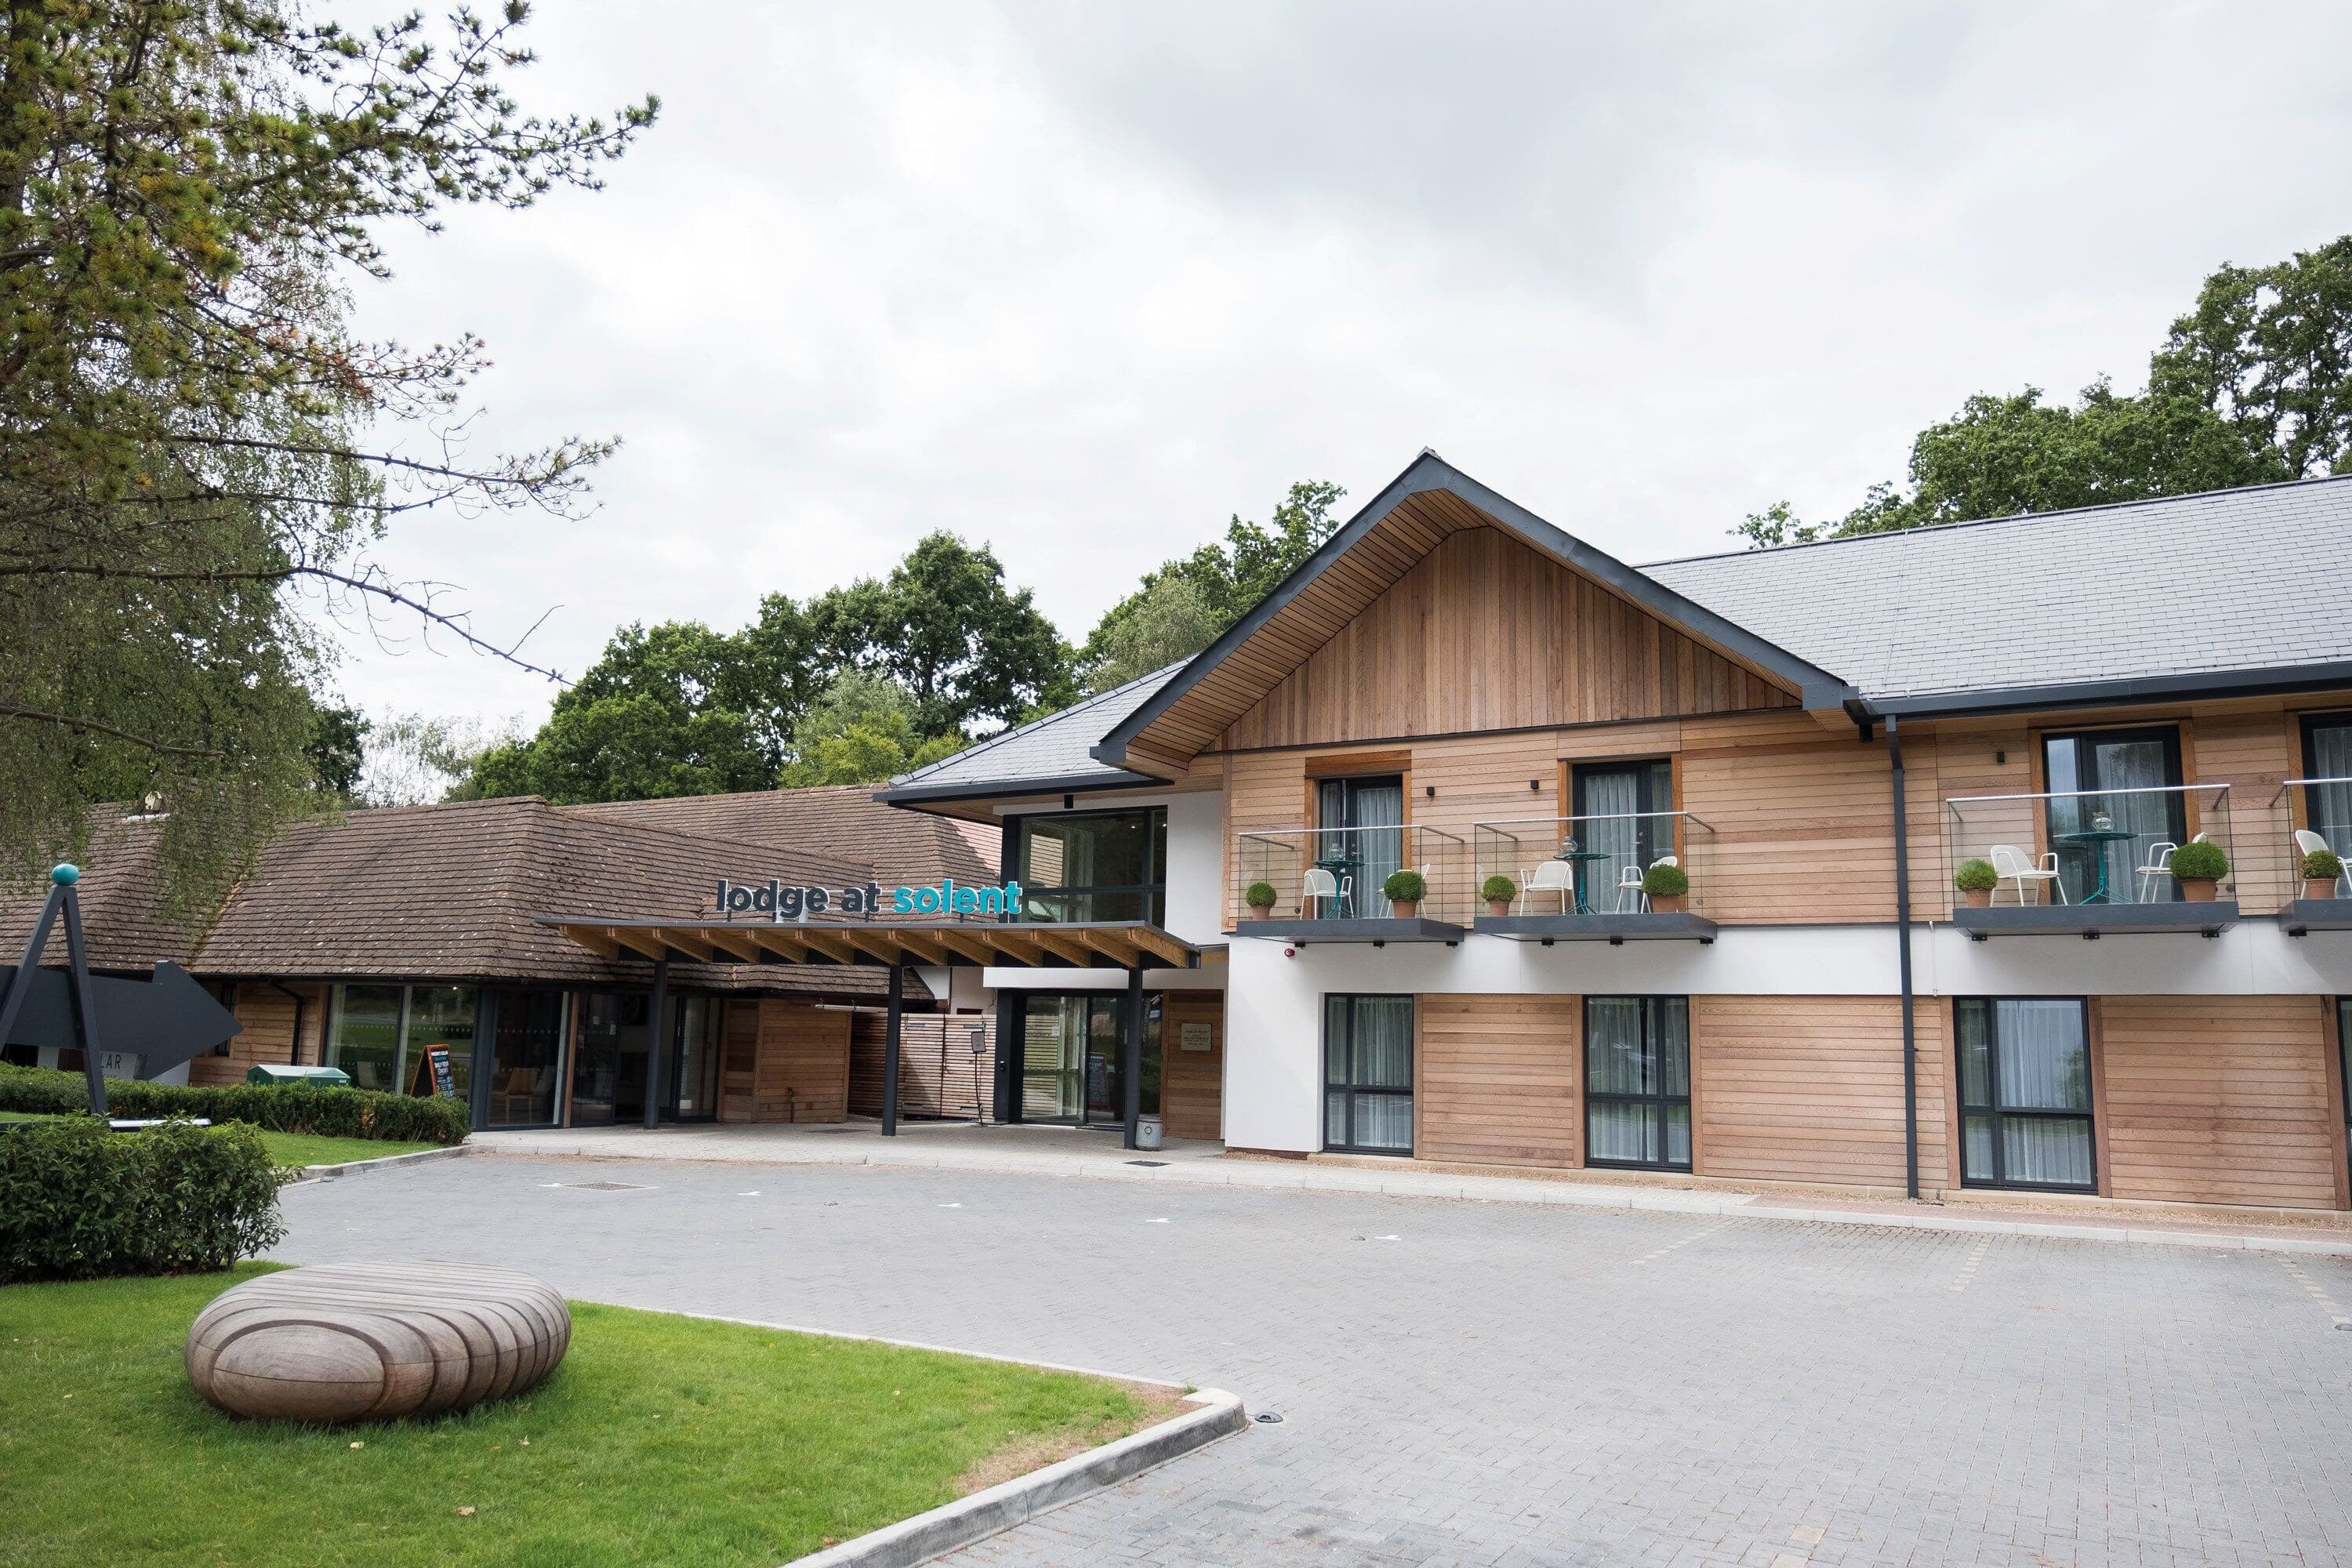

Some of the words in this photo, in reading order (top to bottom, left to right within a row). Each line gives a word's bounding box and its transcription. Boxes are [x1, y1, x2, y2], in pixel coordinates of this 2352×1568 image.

[716, 878, 829, 918] lodge
[840, 880, 882, 913] at
[893, 878, 1022, 914] solent
